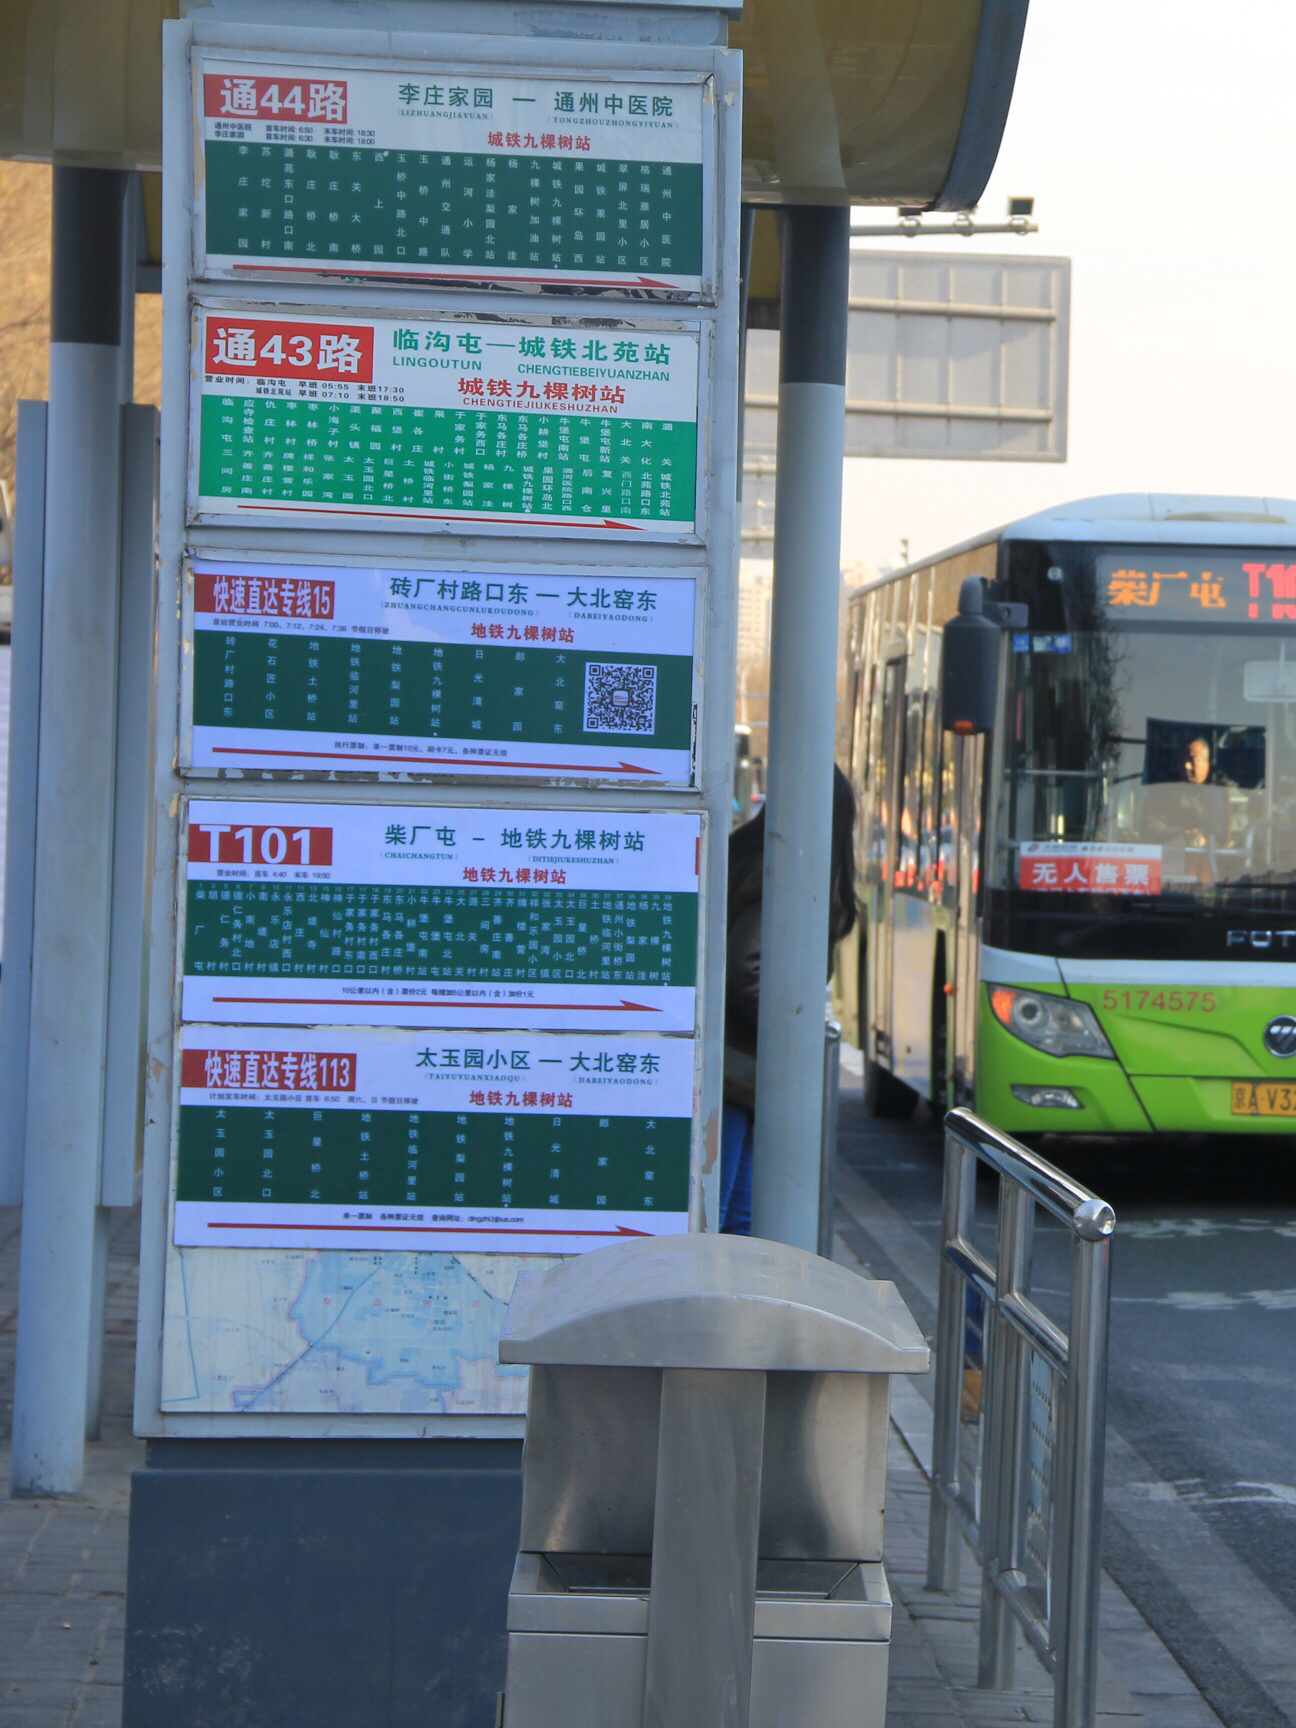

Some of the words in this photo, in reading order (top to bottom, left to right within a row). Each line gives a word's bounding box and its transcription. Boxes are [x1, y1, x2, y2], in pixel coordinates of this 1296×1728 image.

[220, 79, 346, 121] 通44路
[398, 83, 493, 109] 李庄家园
[554, 91, 673, 116] 通州中医院
[488, 131, 591, 151] 城铁九棵树站
[212, 327, 362, 373] 通43路
[393, 355, 482, 371] LINGOUTUN
[518, 363, 669, 381] CHENGTIEBEIYUANZHAN
[257, 379, 286, 387] 临沟屯
[458, 377, 626, 403] 城铁九棵树站
[463, 397, 618, 413] CHENGTIEJIUKESHUZHAN
[213, 576, 331, 618] 快速直达专线15
[390, 576, 528, 604] 砖厂村路口东
[567, 586, 657, 611] 大北窑东
[471, 623, 574, 643] 地铁九棵树站
[199, 825, 310, 864] T101
[385, 824, 456, 847] 柴厂屯
[501, 828, 645, 852] 地铁九棵树站
[463, 867, 566, 884] 地铁九棵树站
[1032, 863, 1149, 885] 无人售票
[1102, 989, 1216, 1011] 5174575
[205, 1051, 350, 1089] 快速直达专线113
[416, 1047, 530, 1070] 太玉园小区
[570, 1052, 659, 1074] 大北窑东
[470, 1091, 573, 1107] 地铁九棵树站
